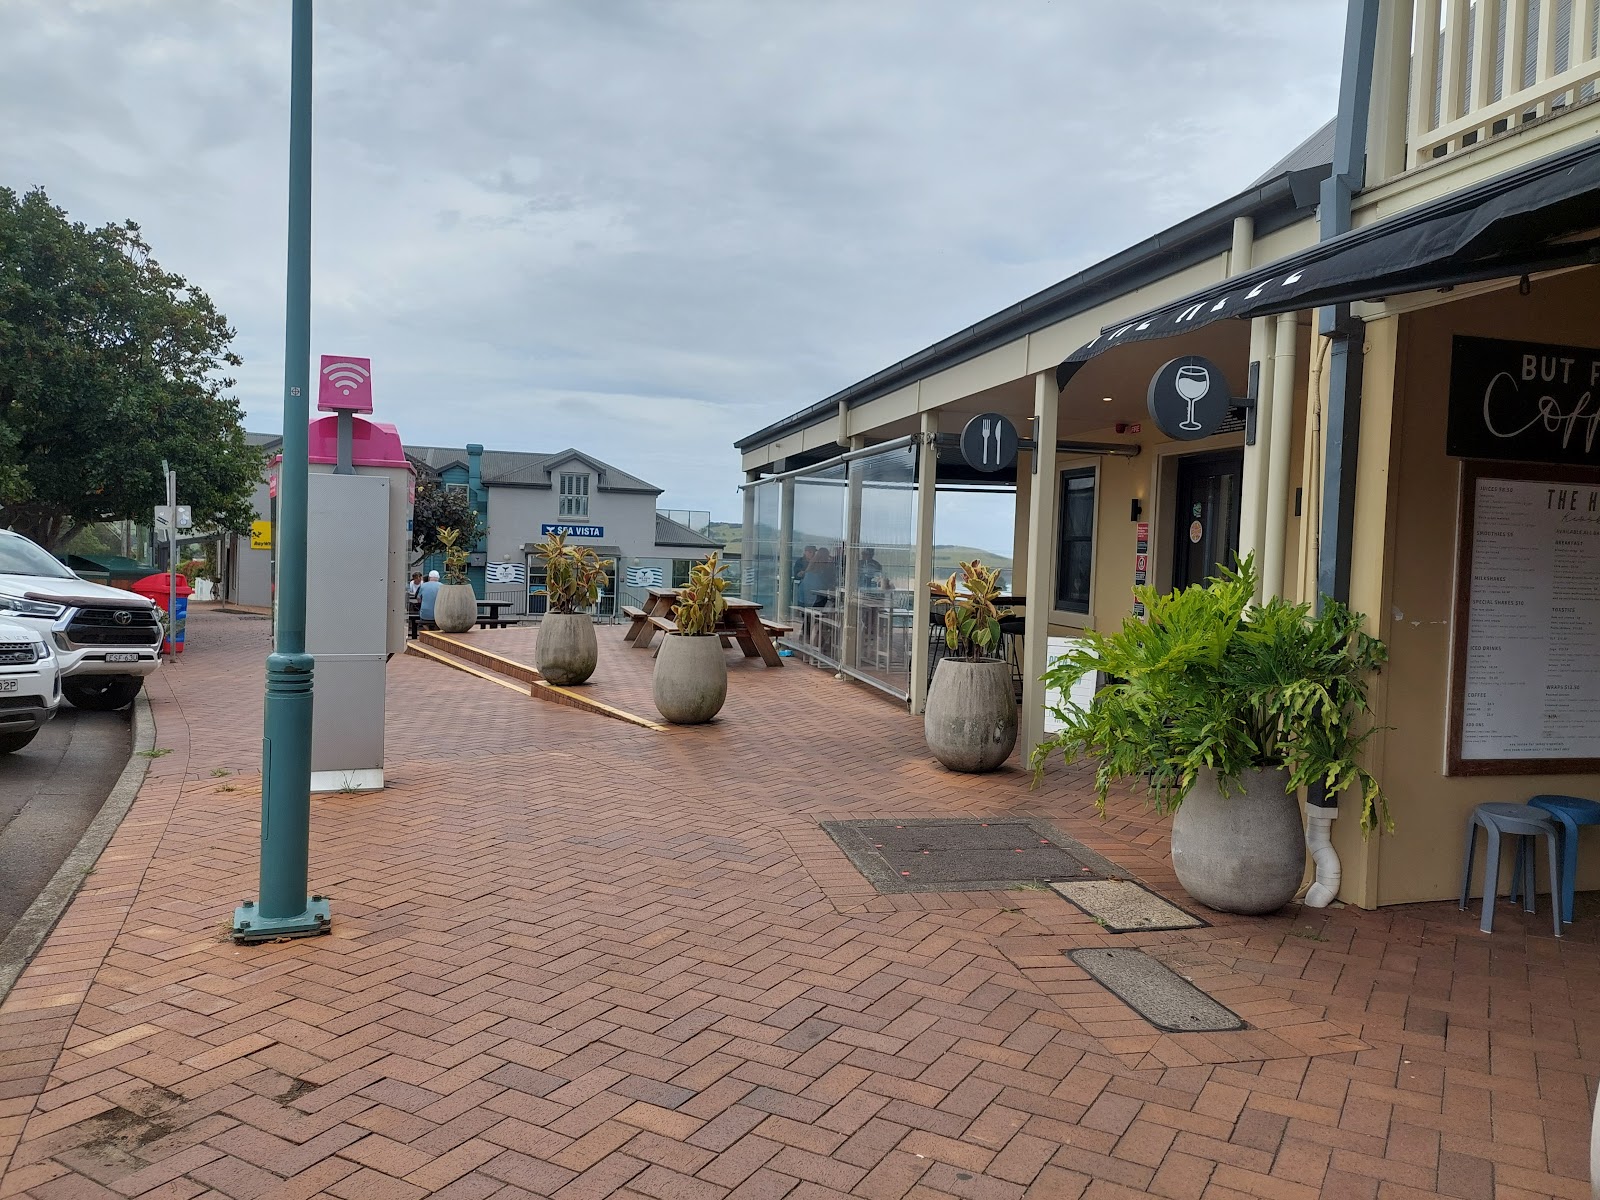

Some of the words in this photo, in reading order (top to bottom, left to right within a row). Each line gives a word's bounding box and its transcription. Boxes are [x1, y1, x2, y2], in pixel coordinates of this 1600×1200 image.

[1521, 354, 1575, 384] BUT
[1547, 489, 1579, 511] THE
[575, 527, 600, 536] VISTA
